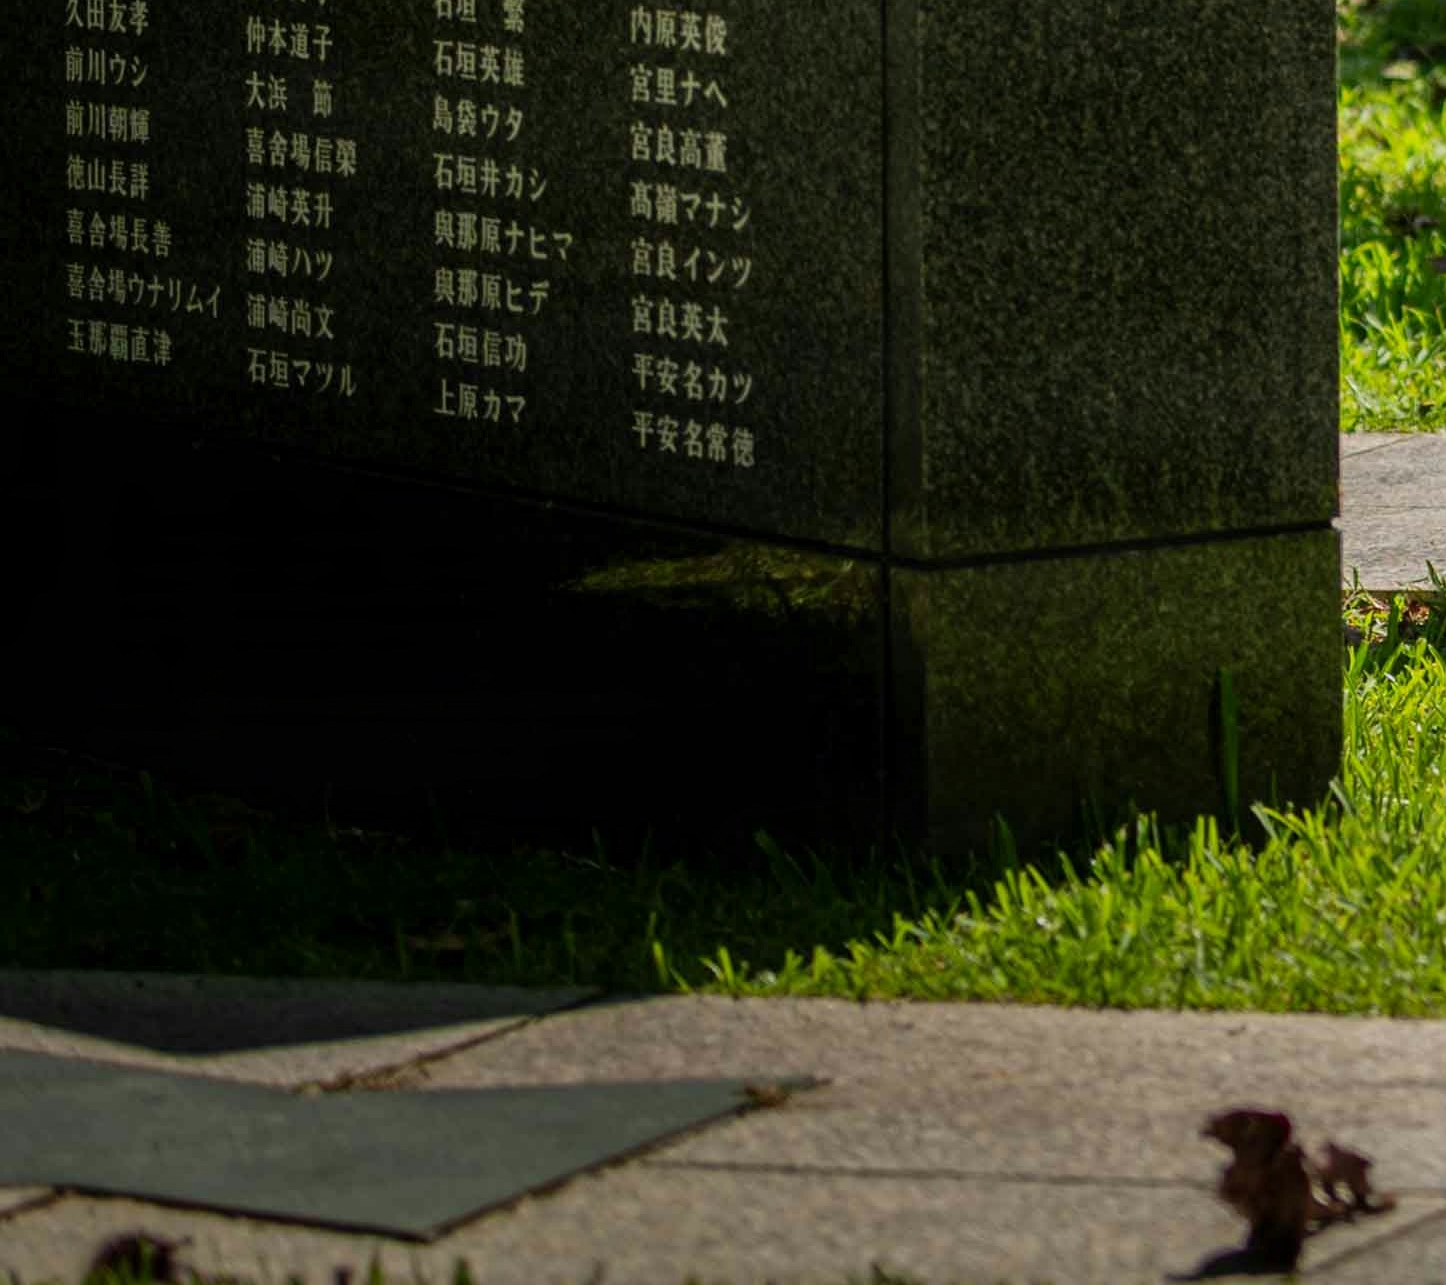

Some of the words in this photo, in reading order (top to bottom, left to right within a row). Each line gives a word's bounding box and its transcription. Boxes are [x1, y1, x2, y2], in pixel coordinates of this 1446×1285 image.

[245, 15, 334, 63] 仲本道子
[432, 38, 526, 88] 石垣英雄
[64, 45, 148, 88] 前川ウシ
[431, 93, 525, 142] 島袋ウタ
[245, 237, 334, 282] 浦崎ハツ
[630, 293, 730, 348] 宮良英太
[433, 321, 528, 374] 石垣信功
[246, 346, 358, 399] 石垣マツル
[631, 352, 754, 405] 平安名カツ
[432, 377, 528, 425] 上原カマ
